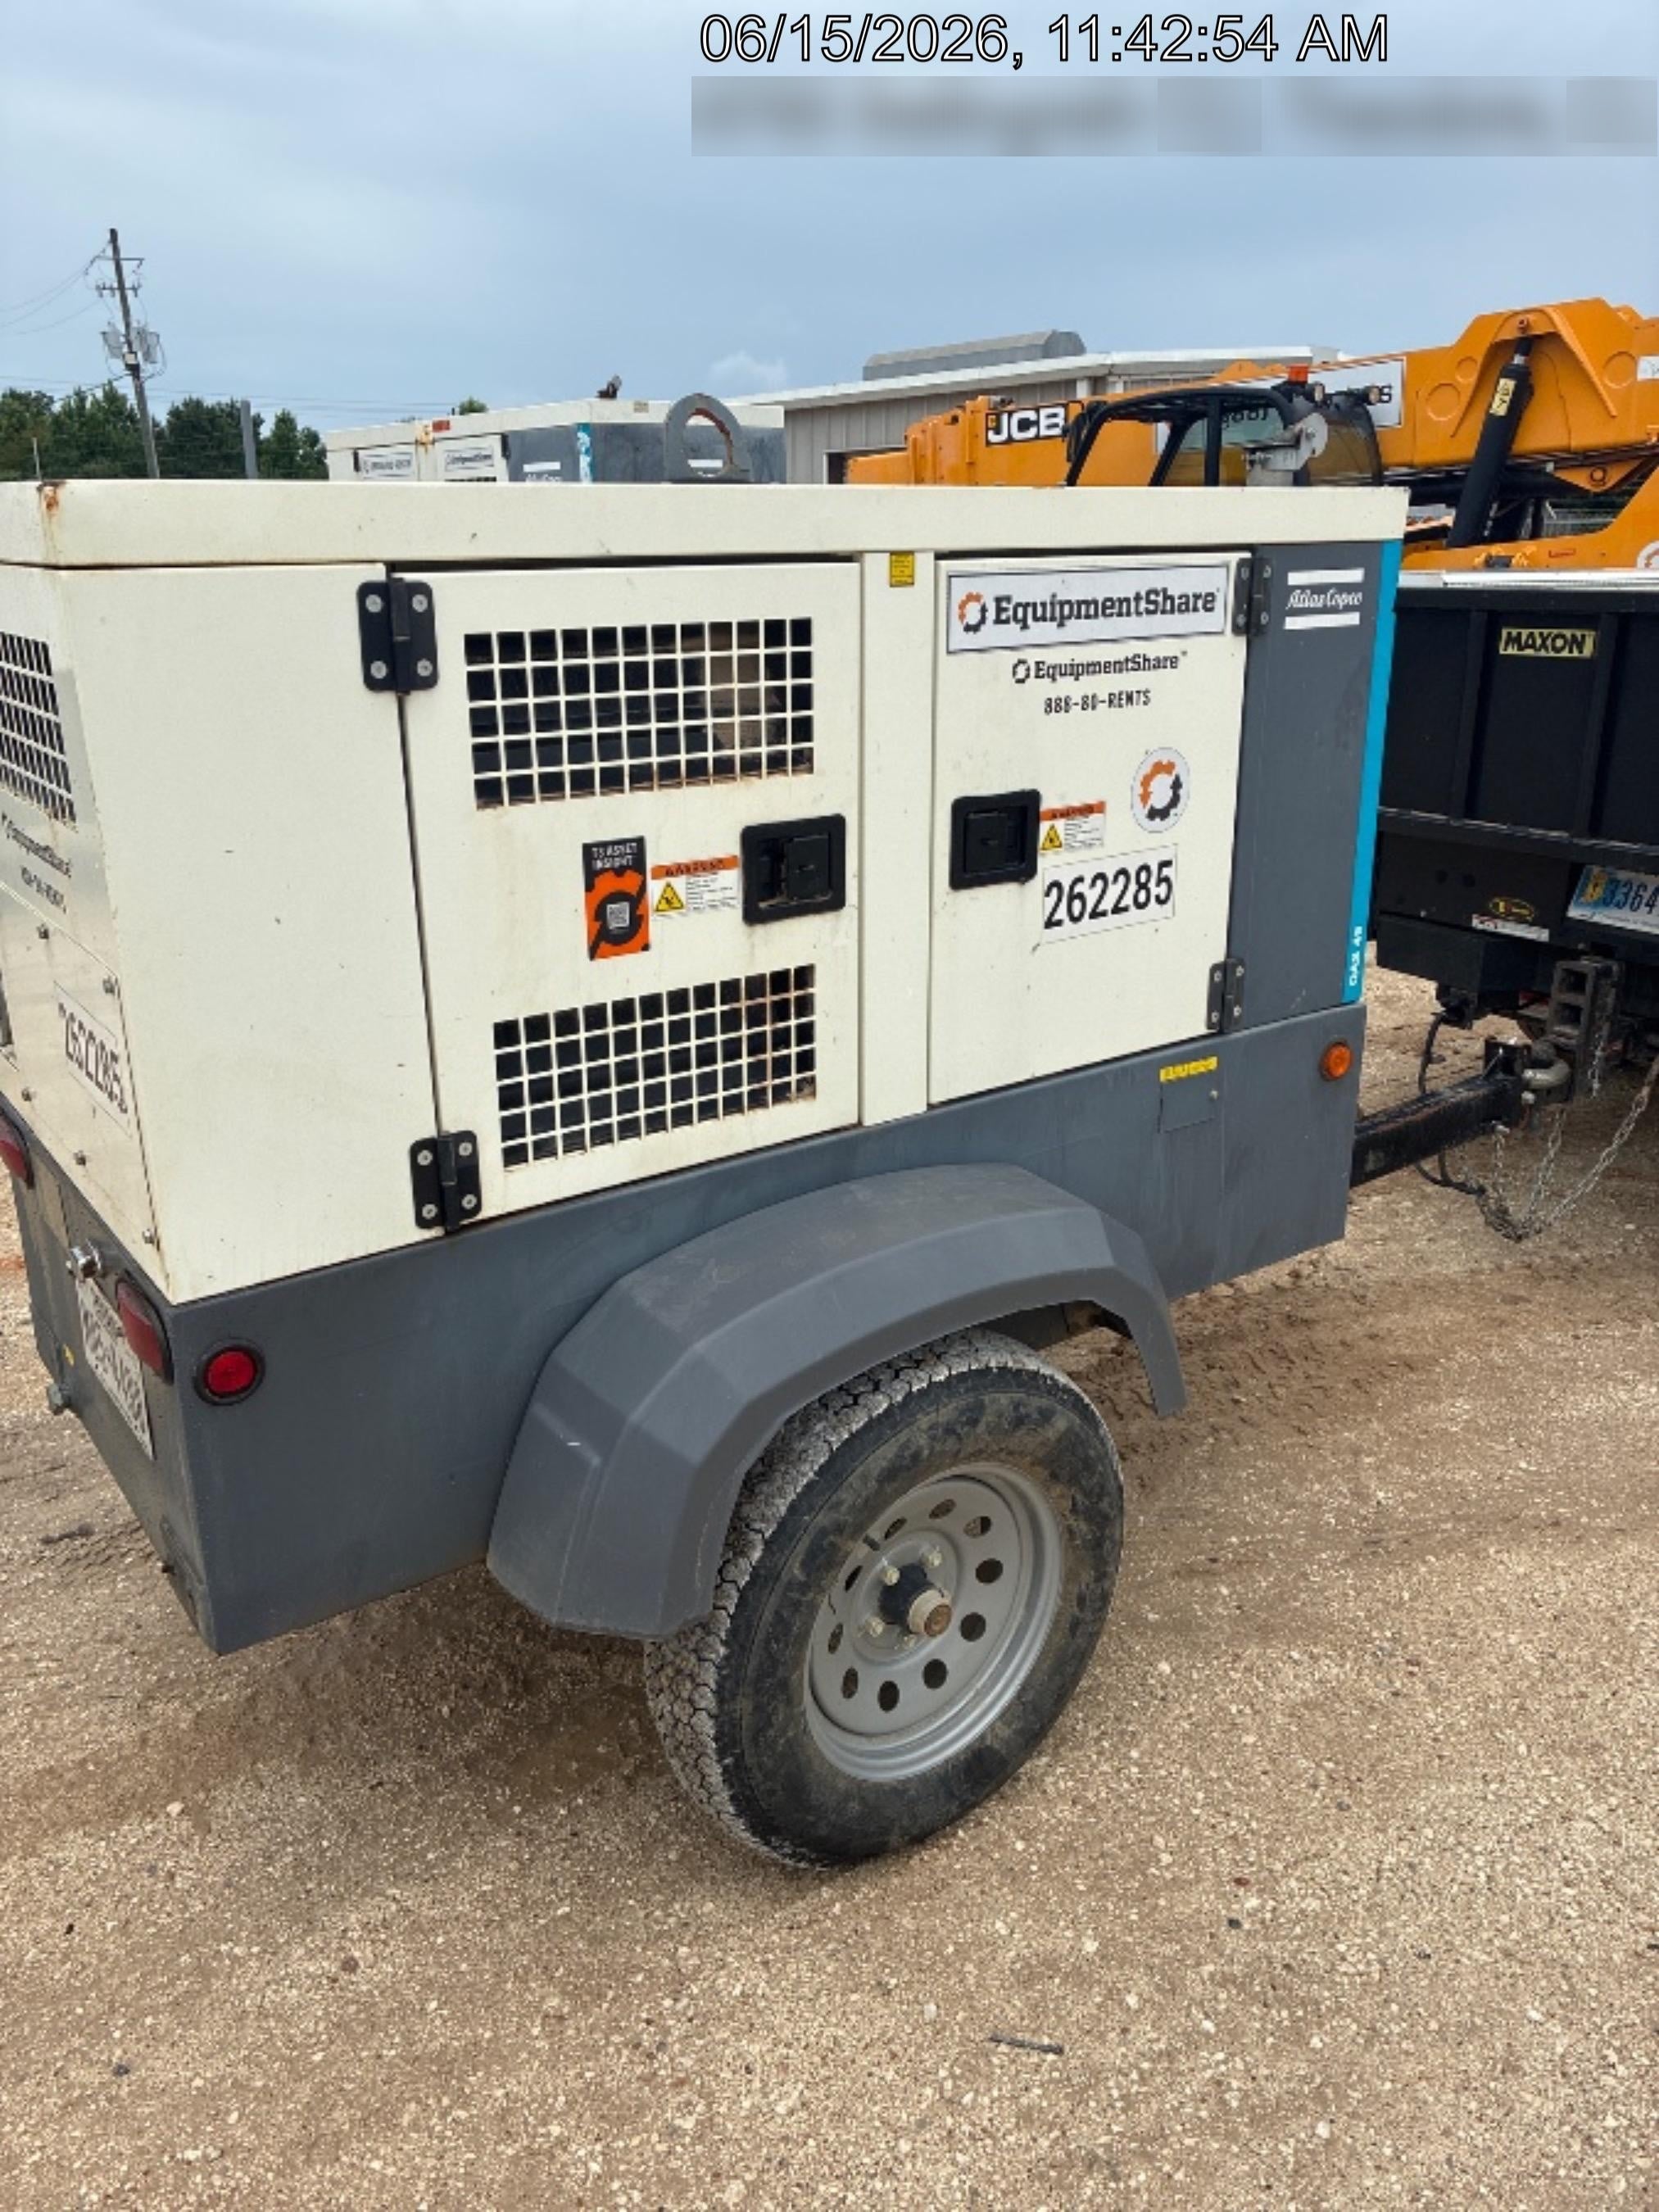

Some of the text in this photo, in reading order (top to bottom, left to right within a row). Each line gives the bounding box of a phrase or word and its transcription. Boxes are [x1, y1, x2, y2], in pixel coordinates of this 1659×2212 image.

[987, 406, 1065, 443] JCB
[993, 587, 1216, 630] EquipmentShare
[1503, 631, 1586, 654] MAXON
[1034, 653, 1179, 682] EquipmentShare
[1044, 690, 1151, 715] 888-80-RENTS
[1044, 859, 1174, 930] 262285
